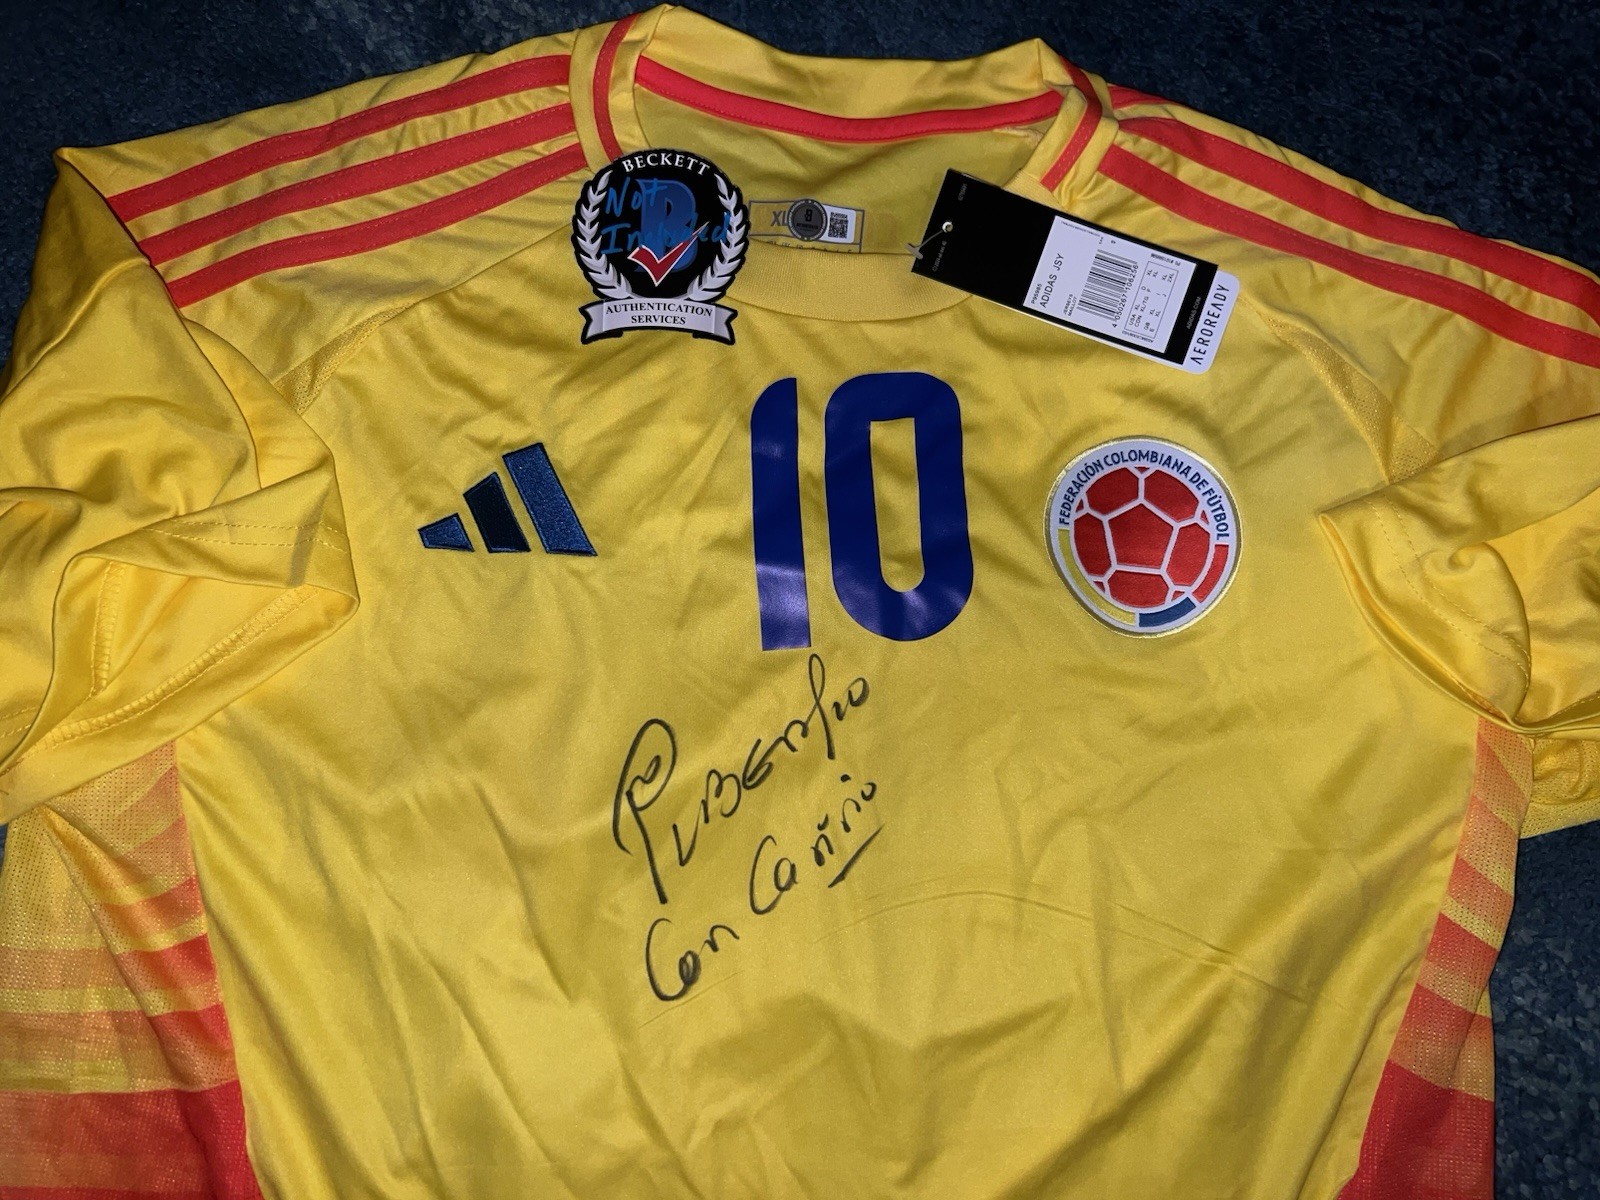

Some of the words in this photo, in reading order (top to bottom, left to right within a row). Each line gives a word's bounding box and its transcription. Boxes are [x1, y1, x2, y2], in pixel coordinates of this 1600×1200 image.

[621, 152, 710, 176] BECKETT
[1039, 274, 1057, 309] ADIDAS
[1053, 253, 1064, 271] JSY
[605, 302, 713, 317] AUTHENTICATION
[631, 314, 686, 326] SERVICES
[1128, 314, 1136, 326] USA
[1190, 284, 1229, 365] AEROREADY
[749, 371, 974, 652] 10
[1058, 459, 1105, 526] FEDERACIÓN
[1103, 449, 1193, 477] COLOMBIANA
[1188, 471, 1209, 491] DE
[1201, 490, 1230, 541] FÚTBOL
[645, 917, 740, 1002] Con
